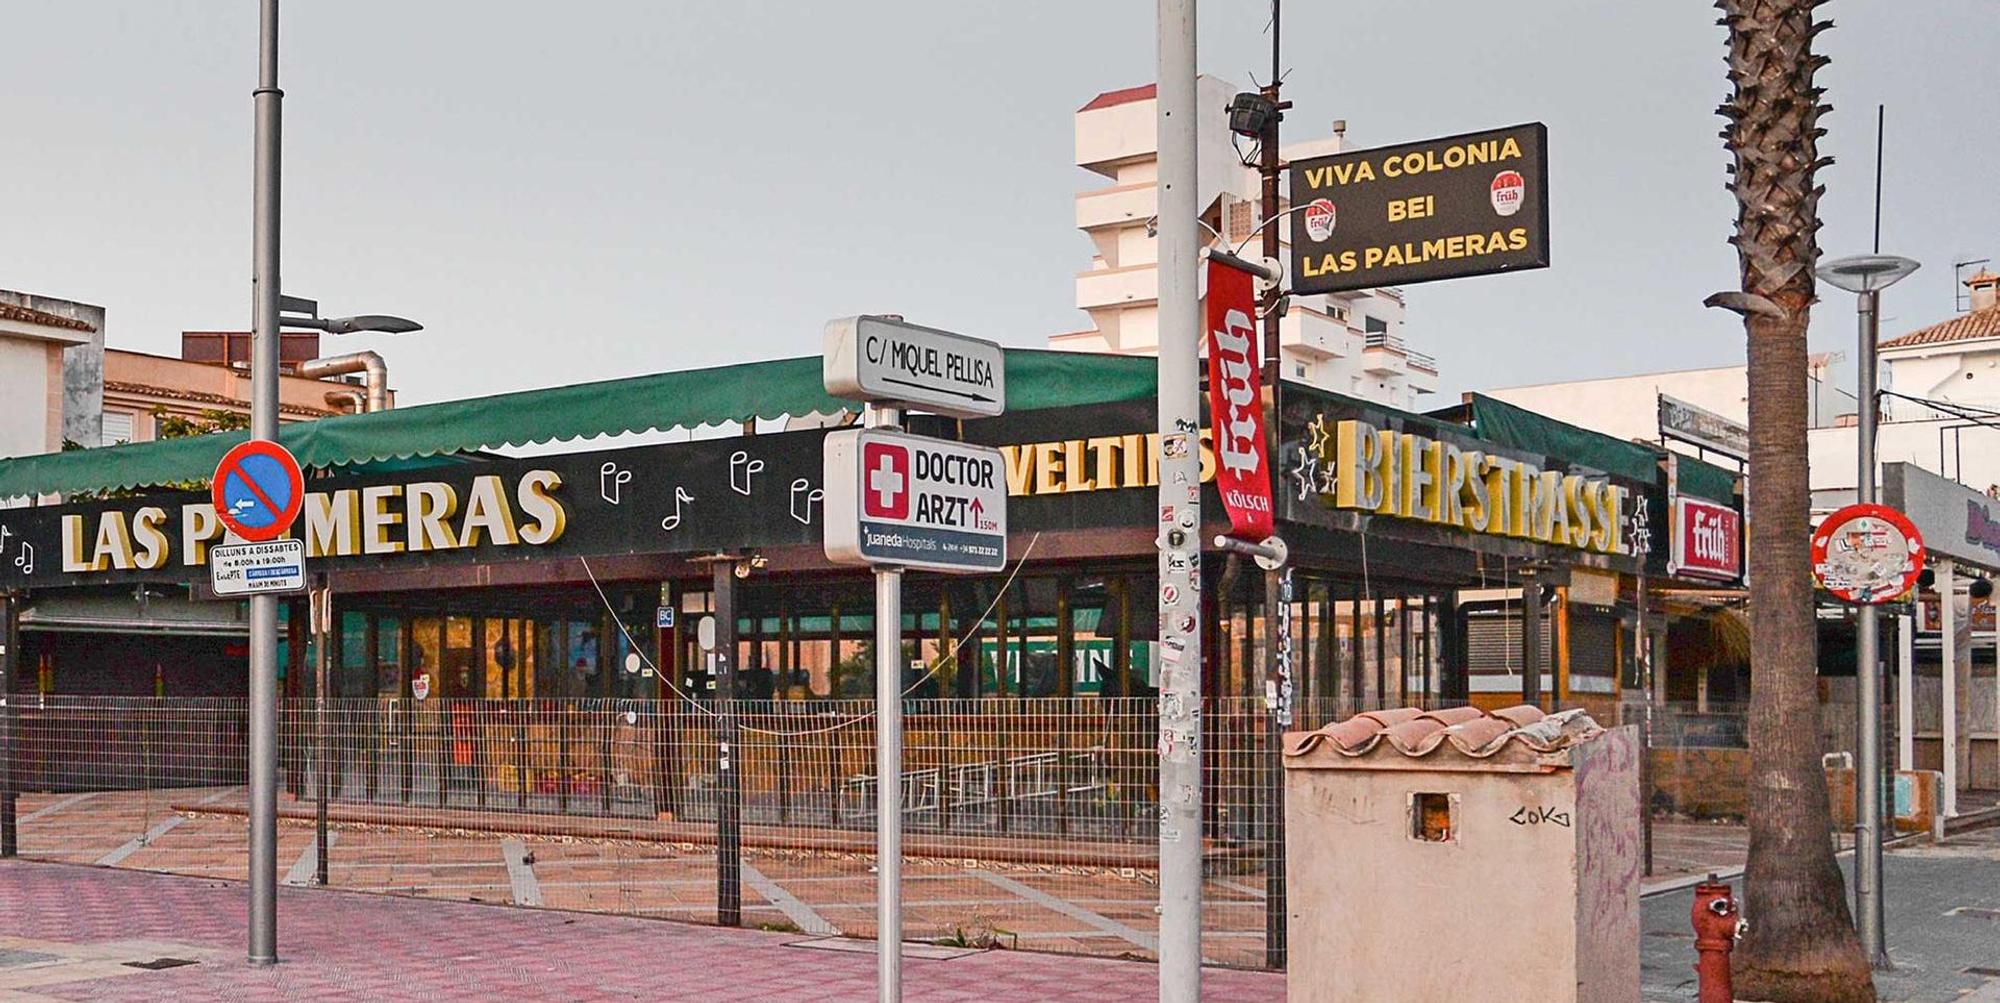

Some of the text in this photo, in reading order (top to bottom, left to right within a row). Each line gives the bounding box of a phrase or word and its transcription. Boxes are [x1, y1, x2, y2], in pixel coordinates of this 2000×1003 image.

[1305, 137, 1522, 189] VIVA COLONIA
[1388, 195, 1434, 222] BEI
[1303, 227, 1528, 278] LAS PALMERAS
[866, 336, 994, 388] C/ MIQUEL PELLISA
[915, 450, 994, 490] DOCTOR
[1337, 419, 1630, 555] BIERSTRASSE
[61, 469, 567, 573] LAS PMERAS
[915, 492, 969, 527] ARZT
[1226, 491, 1270, 512] KÖLSCH
[214, 543, 299, 558] DILLUNS A DISSABTES
[1692, 509, 1725, 567] früh
[659, 609, 671, 620] BC
